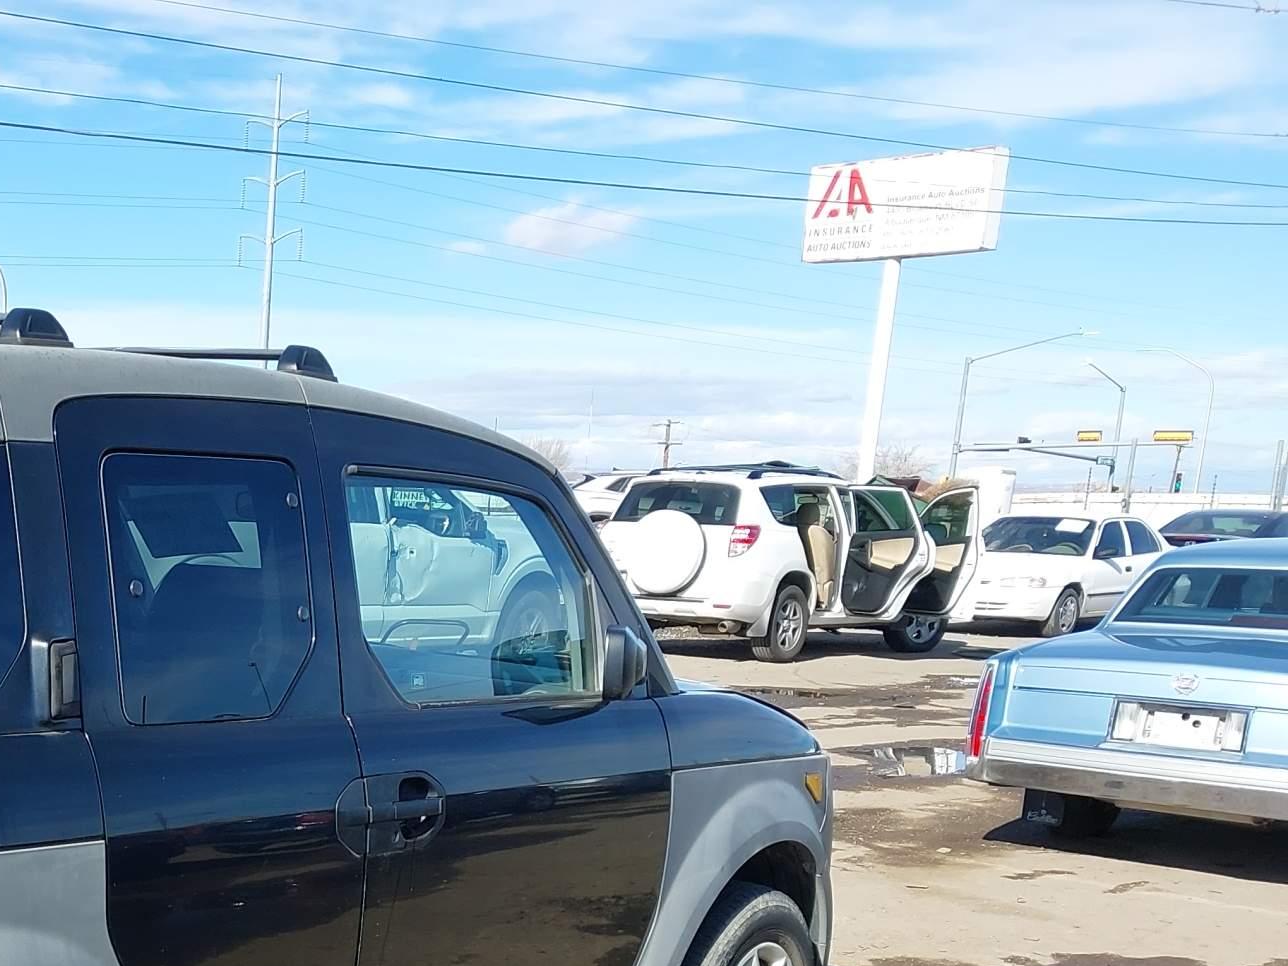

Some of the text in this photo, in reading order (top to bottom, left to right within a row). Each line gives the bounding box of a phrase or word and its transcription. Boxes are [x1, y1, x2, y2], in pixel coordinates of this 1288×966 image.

[928, 190, 946, 199] Auto
[807, 223, 874, 238] INSURANCE
[807, 242, 829, 252] AUTO
[830, 239, 872, 251] AUCTIONS
